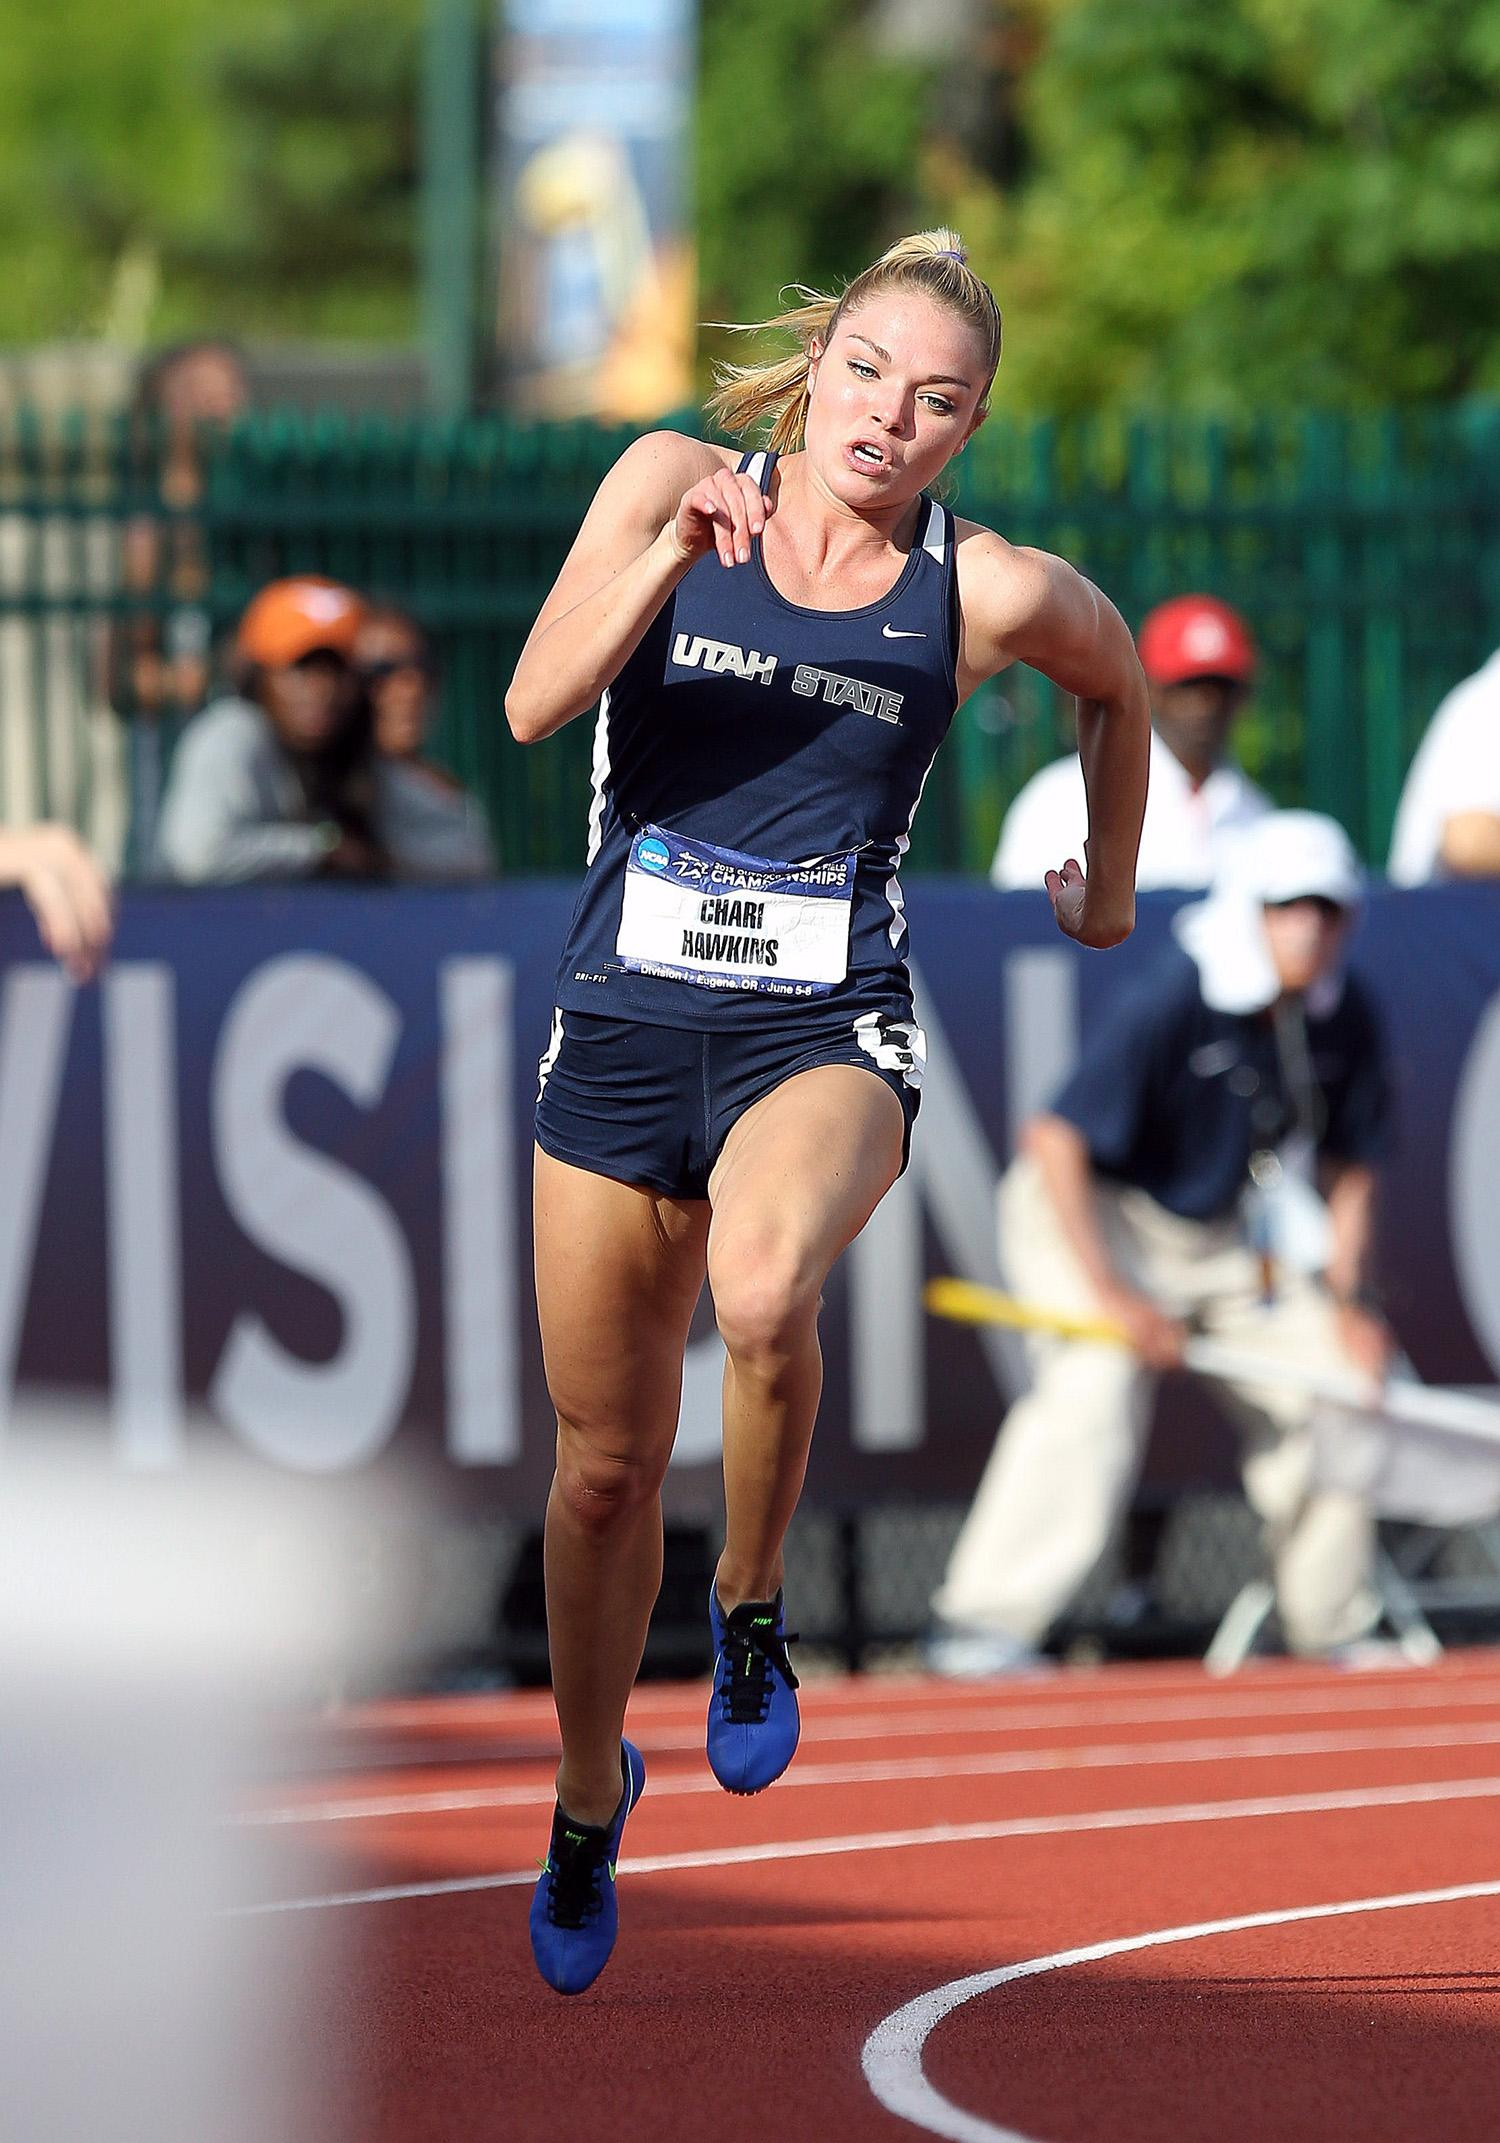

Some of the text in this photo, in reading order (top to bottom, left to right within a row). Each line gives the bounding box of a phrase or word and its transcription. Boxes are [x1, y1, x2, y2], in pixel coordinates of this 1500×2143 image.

[671, 632, 904, 725] UTAH STATE
[639, 849, 669, 867] NCAA
[700, 898, 764, 930] CHARI
[681, 929, 779, 967] HAWKINS
[574, 971, 608, 984] DRI-FIT
[640, 963, 683, 980] Division
[697, 974, 739, 990] Eugene,
[741, 979, 758, 991] OR
[767, 982, 793, 995] June
[795, 984, 812, 996] 5-8
